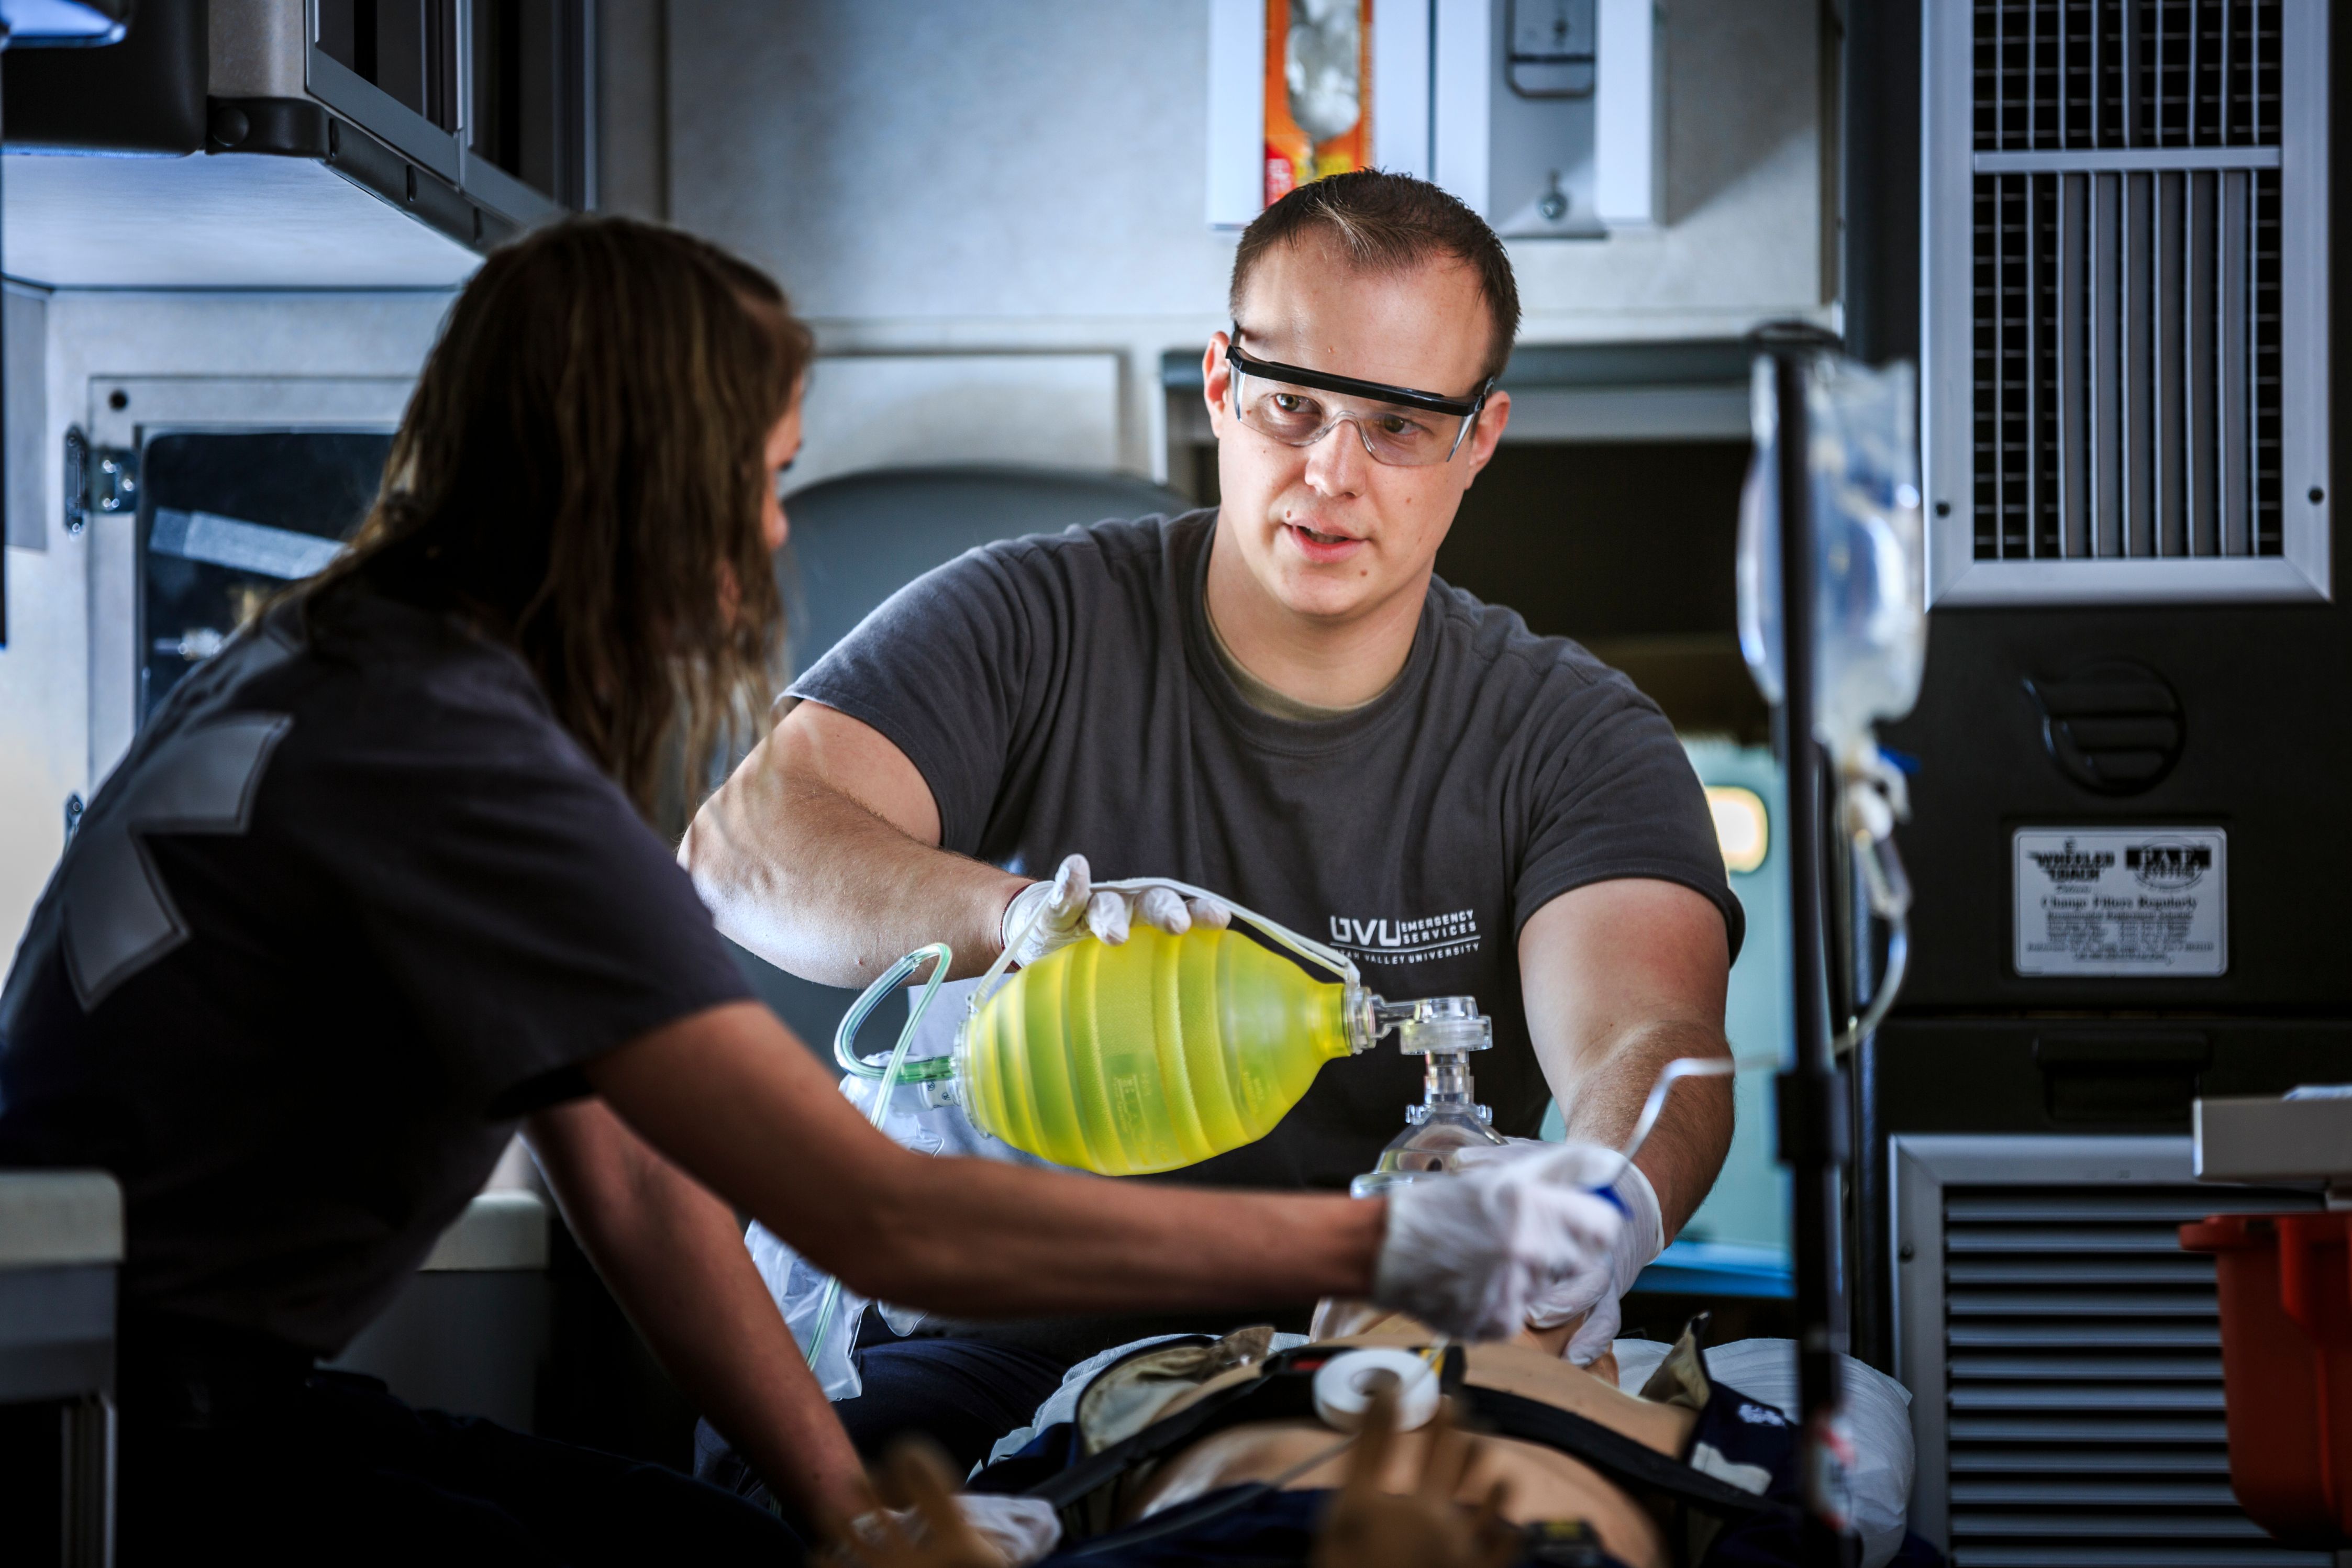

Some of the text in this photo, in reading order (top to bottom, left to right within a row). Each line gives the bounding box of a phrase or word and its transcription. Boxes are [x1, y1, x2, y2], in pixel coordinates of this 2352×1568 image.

[1330, 915, 1401, 947] UVU
[1401, 909, 1473, 932] EMERGENCY
[1403, 921, 1477, 944] SERVICES
[1364, 953, 1405, 964] VALLEY
[1408, 942, 1479, 963] UNIVERSITY
